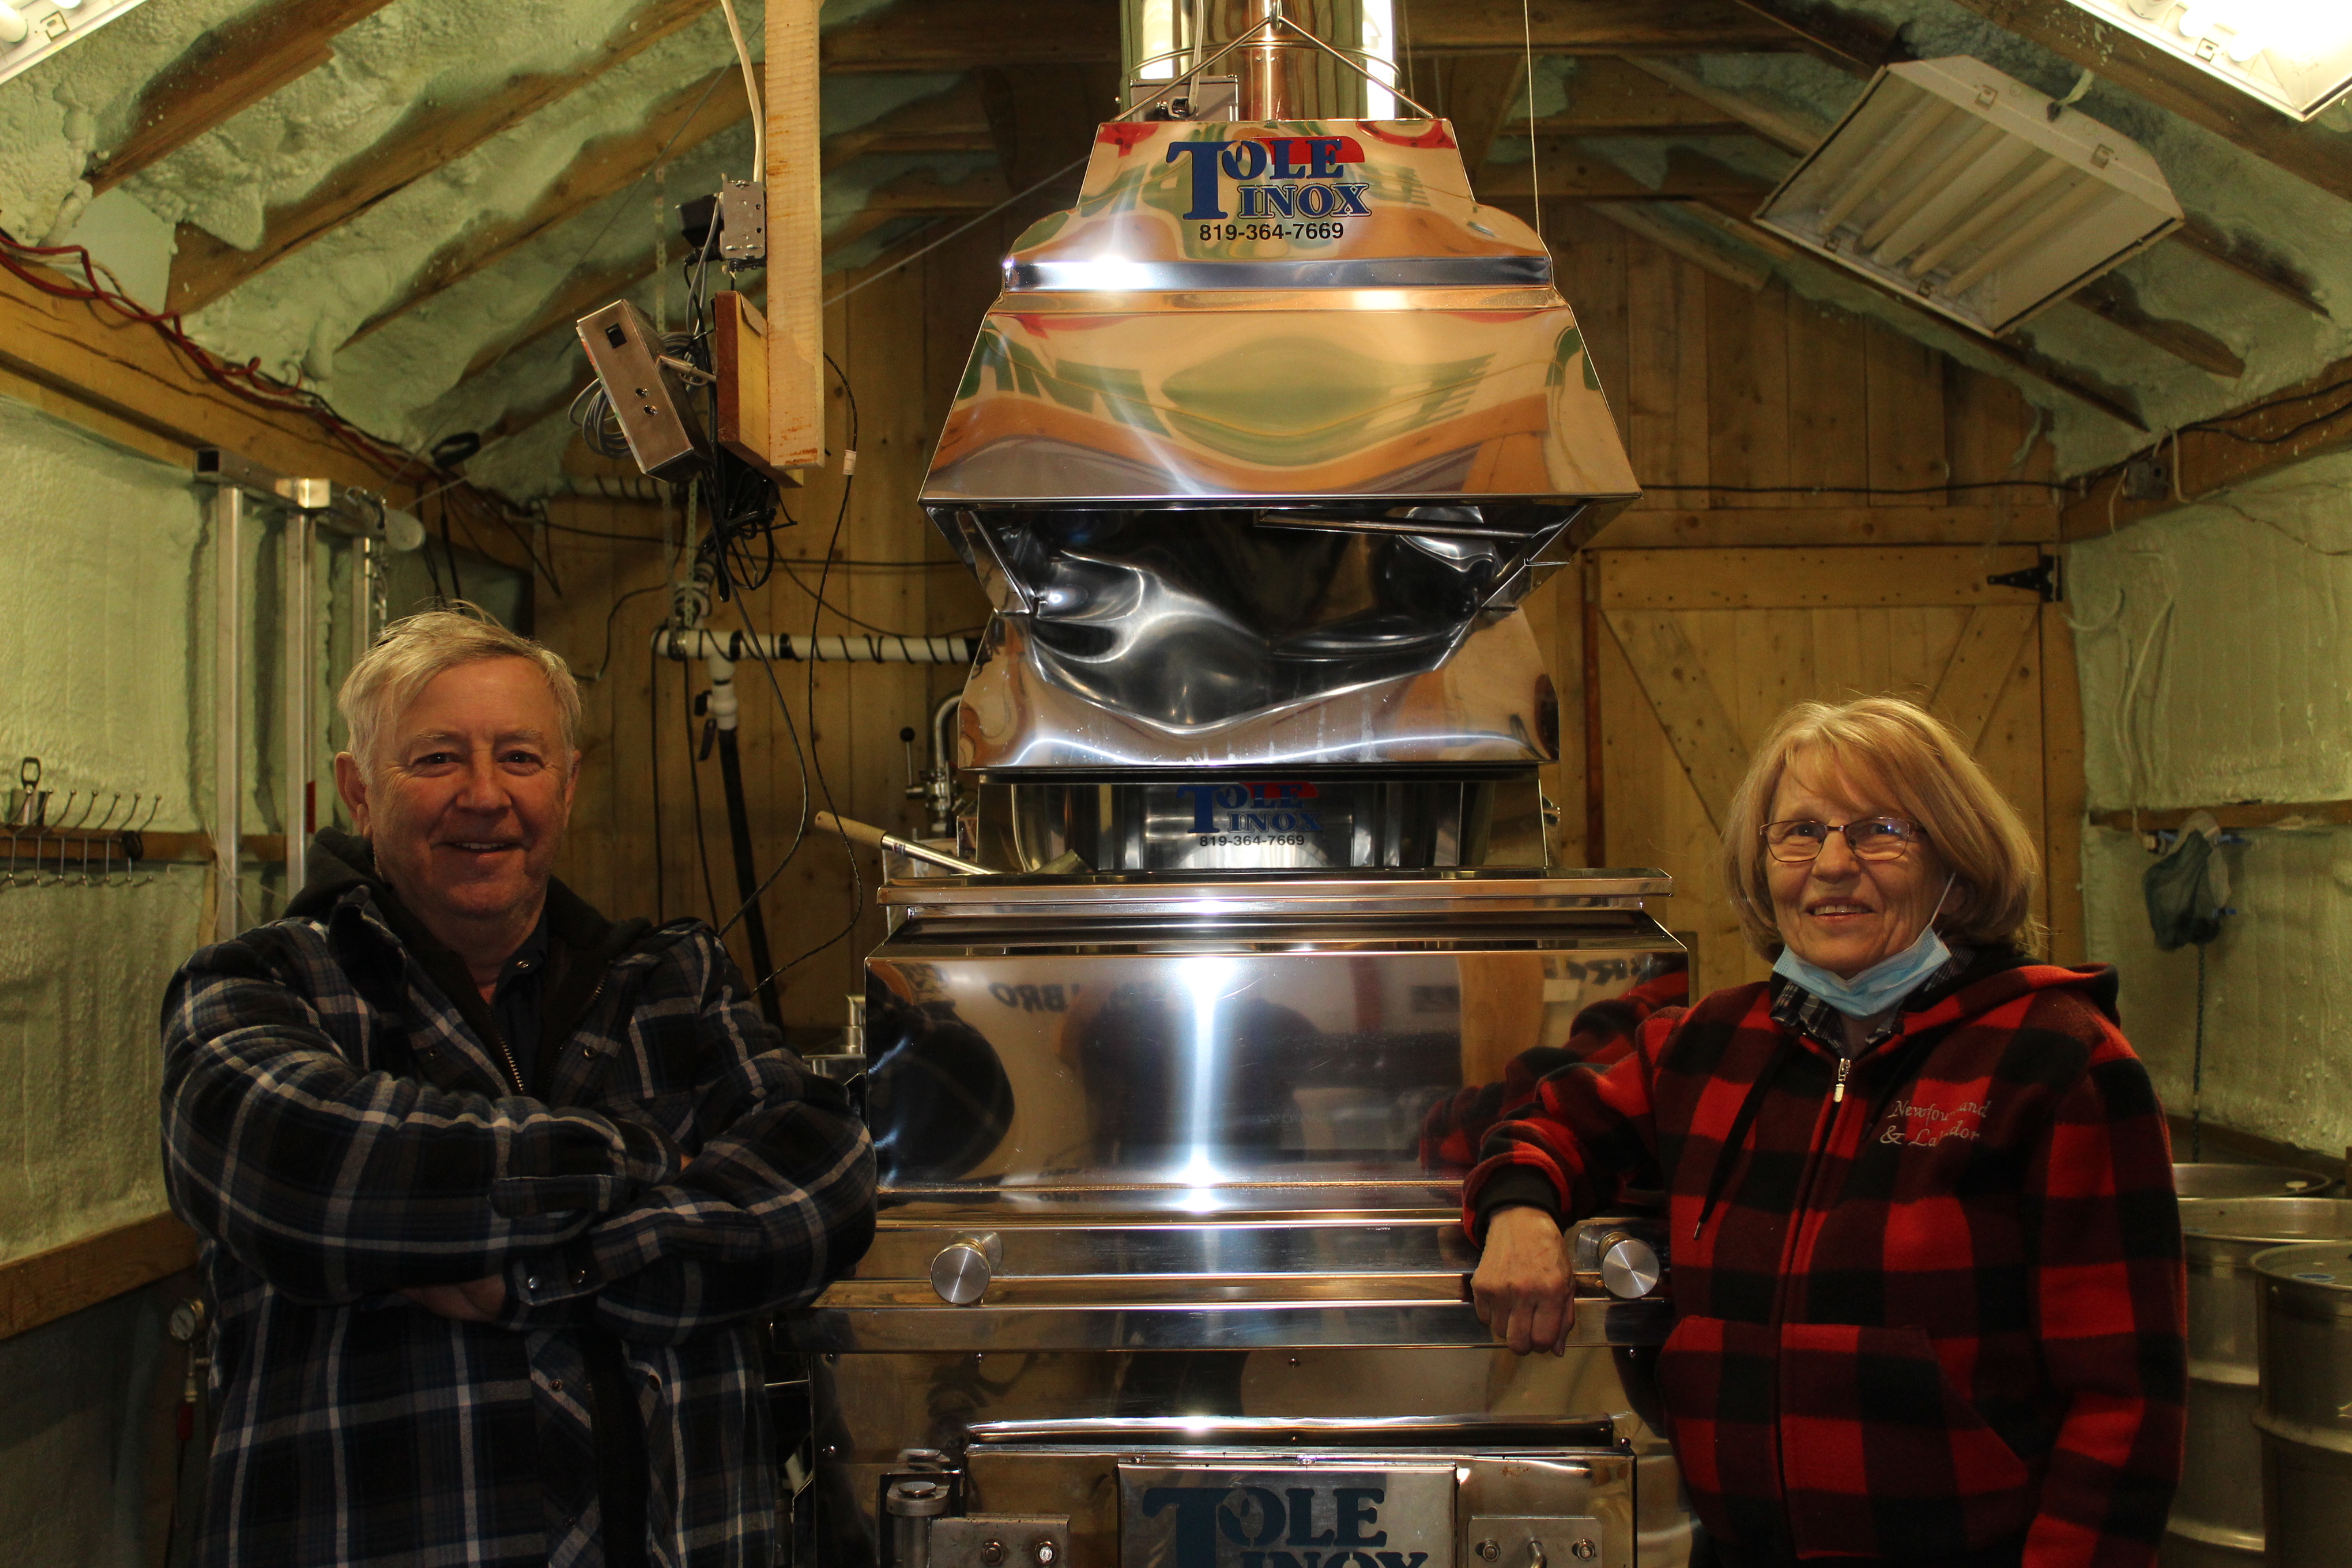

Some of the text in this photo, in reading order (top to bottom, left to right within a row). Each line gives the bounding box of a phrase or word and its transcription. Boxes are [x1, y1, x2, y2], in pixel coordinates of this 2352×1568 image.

[1166, 139, 1345, 220] TOLE
[1237, 182, 1372, 219] INOX
[1198, 222, 1344, 241] 819-364-7669
[1176, 783, 1305, 834] TOLE
[1226, 811, 1324, 833] INOX
[1199, 834, 1305, 847] 819-364-7669
[1880, 1125, 1905, 1145] &
